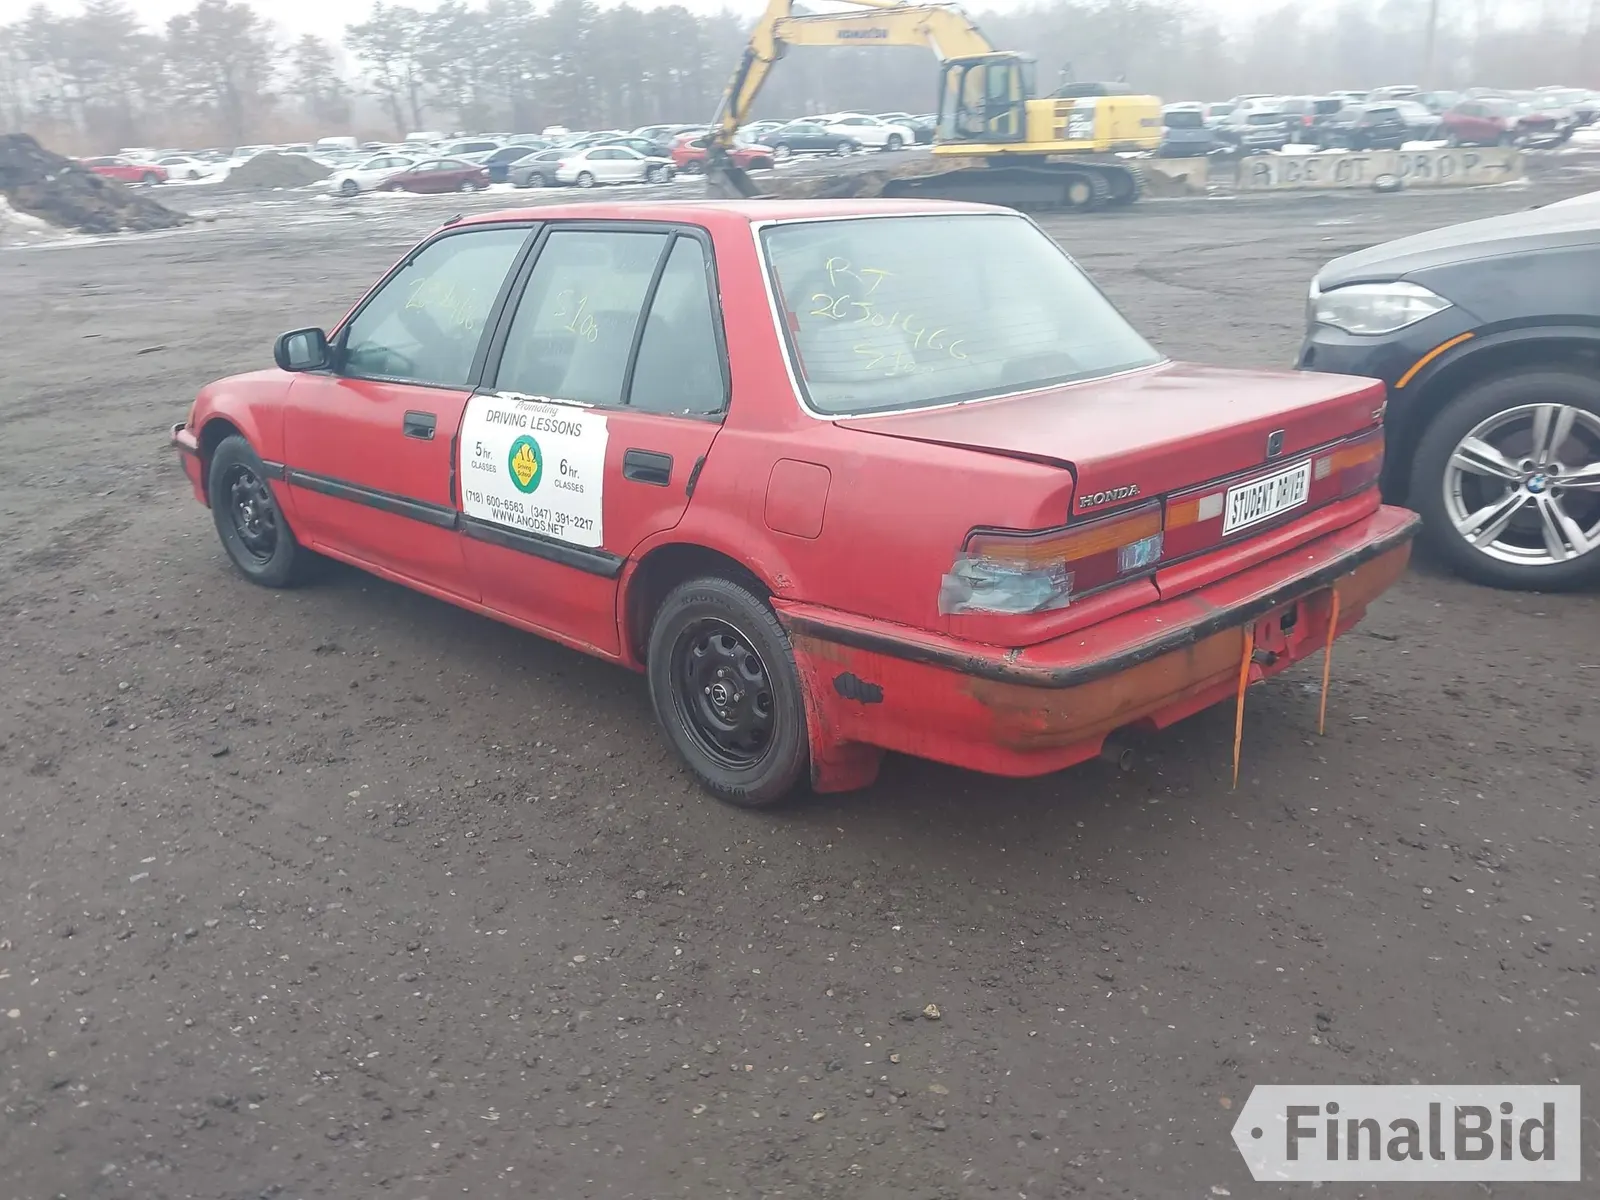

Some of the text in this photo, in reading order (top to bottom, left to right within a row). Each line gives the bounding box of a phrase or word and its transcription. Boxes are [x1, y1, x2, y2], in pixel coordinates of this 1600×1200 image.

[515, 400, 559, 417] Promoting
[486, 409, 582, 437] DRIVING LESSONS
[475, 441, 493, 460] 5 hr.
[471, 460, 497, 473] CLASSES
[559, 458, 580, 479] 6 hr.
[465, 489, 484, 504] (718)
[554, 479, 584, 494] CLASSES
[1079, 484, 1141, 508] HONDA
[1231, 481, 1275, 525] STUDENT
[491, 507, 565, 536] WWW.ANODS.NET
[530, 505, 593, 531] (347) 391-2217
